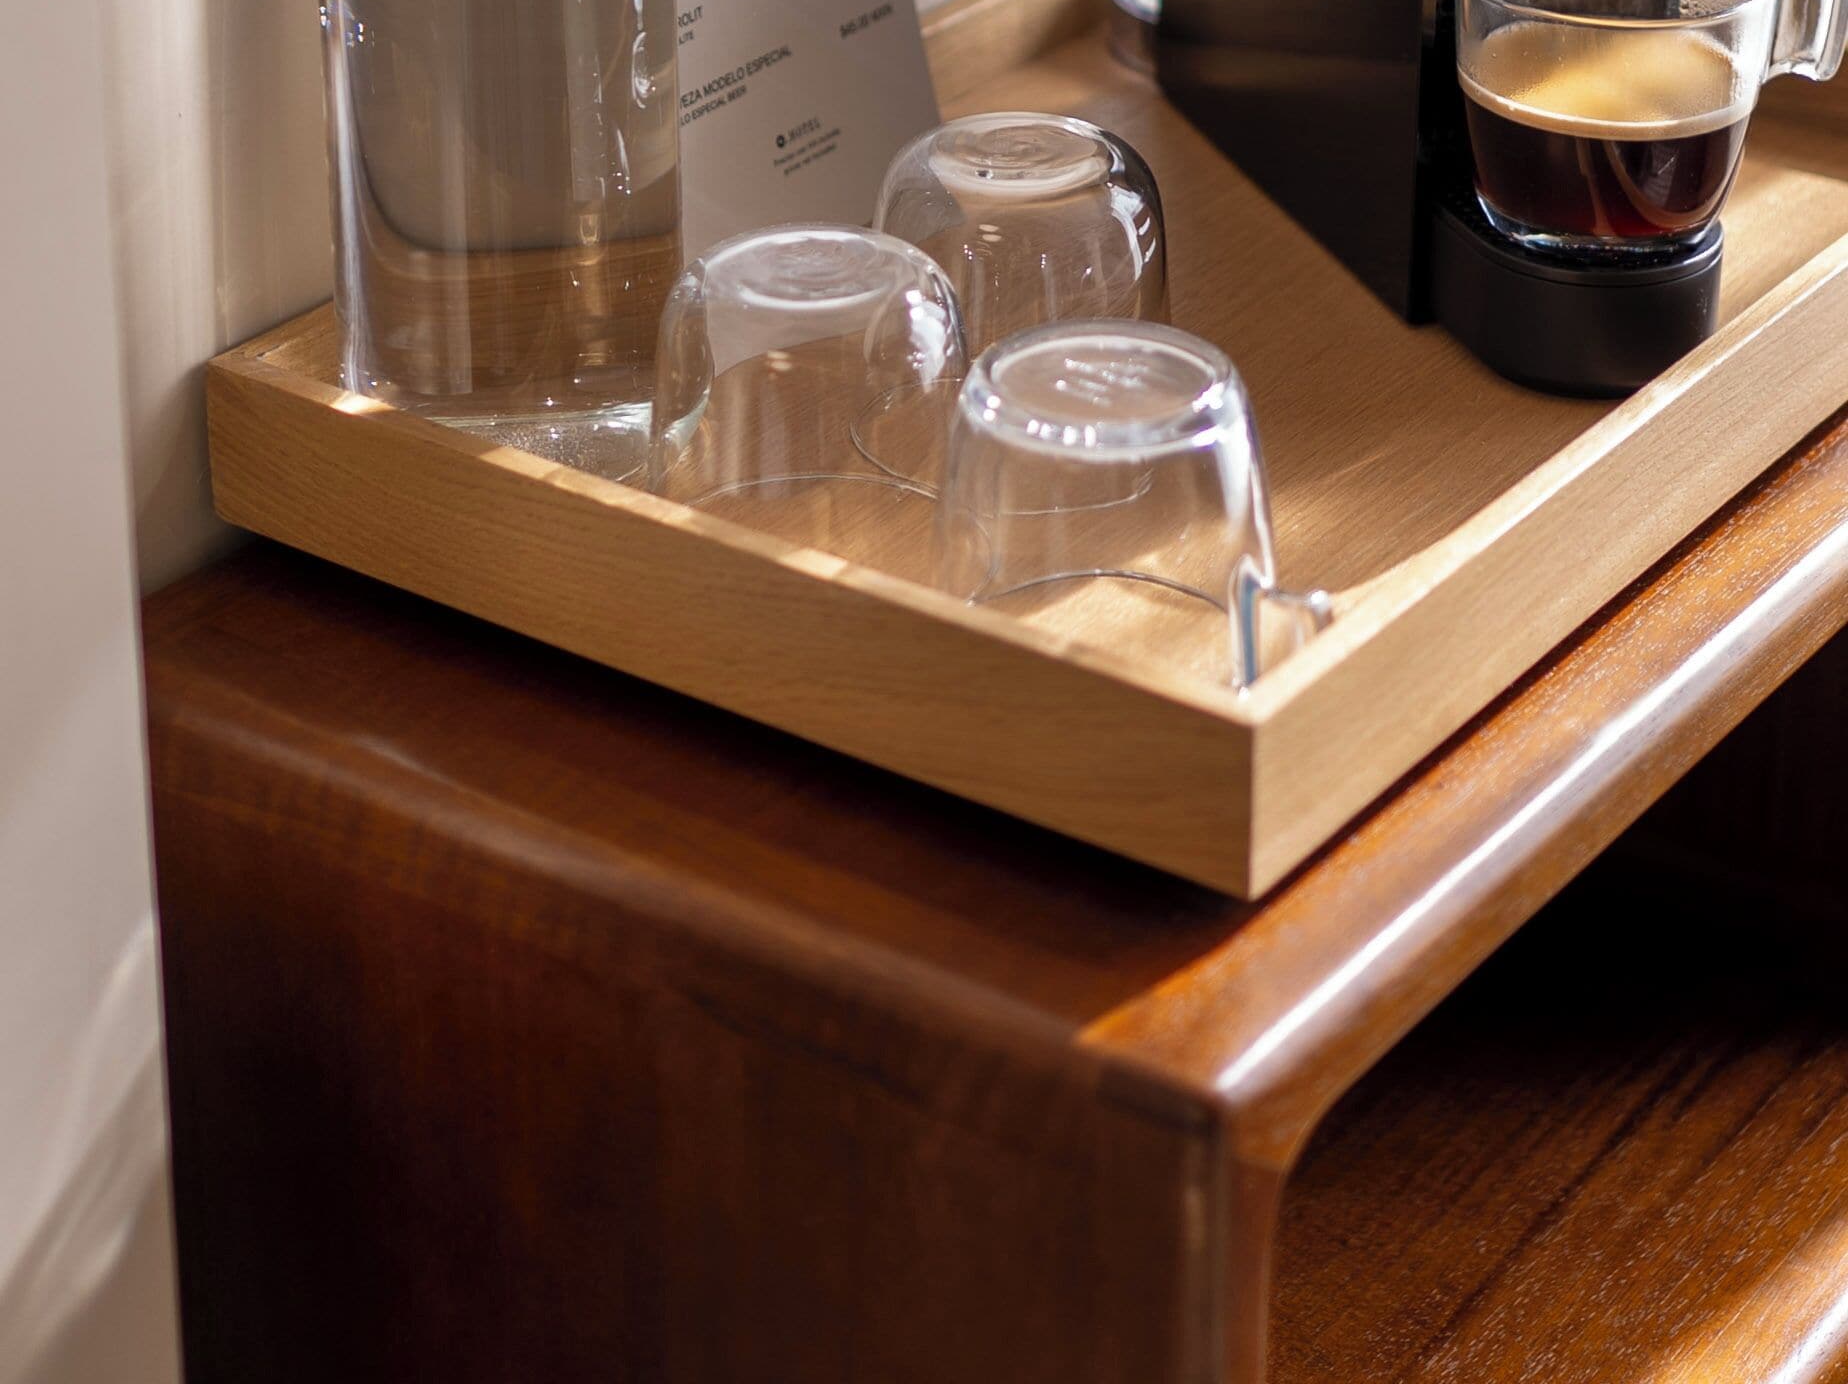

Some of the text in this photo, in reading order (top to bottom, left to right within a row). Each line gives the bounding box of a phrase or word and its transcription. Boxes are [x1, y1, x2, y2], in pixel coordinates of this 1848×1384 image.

[703, 66, 745, 97] MODELO
[745, 44, 792, 77] ESPECIAL
[692, 98, 727, 120] ESPECIAL
